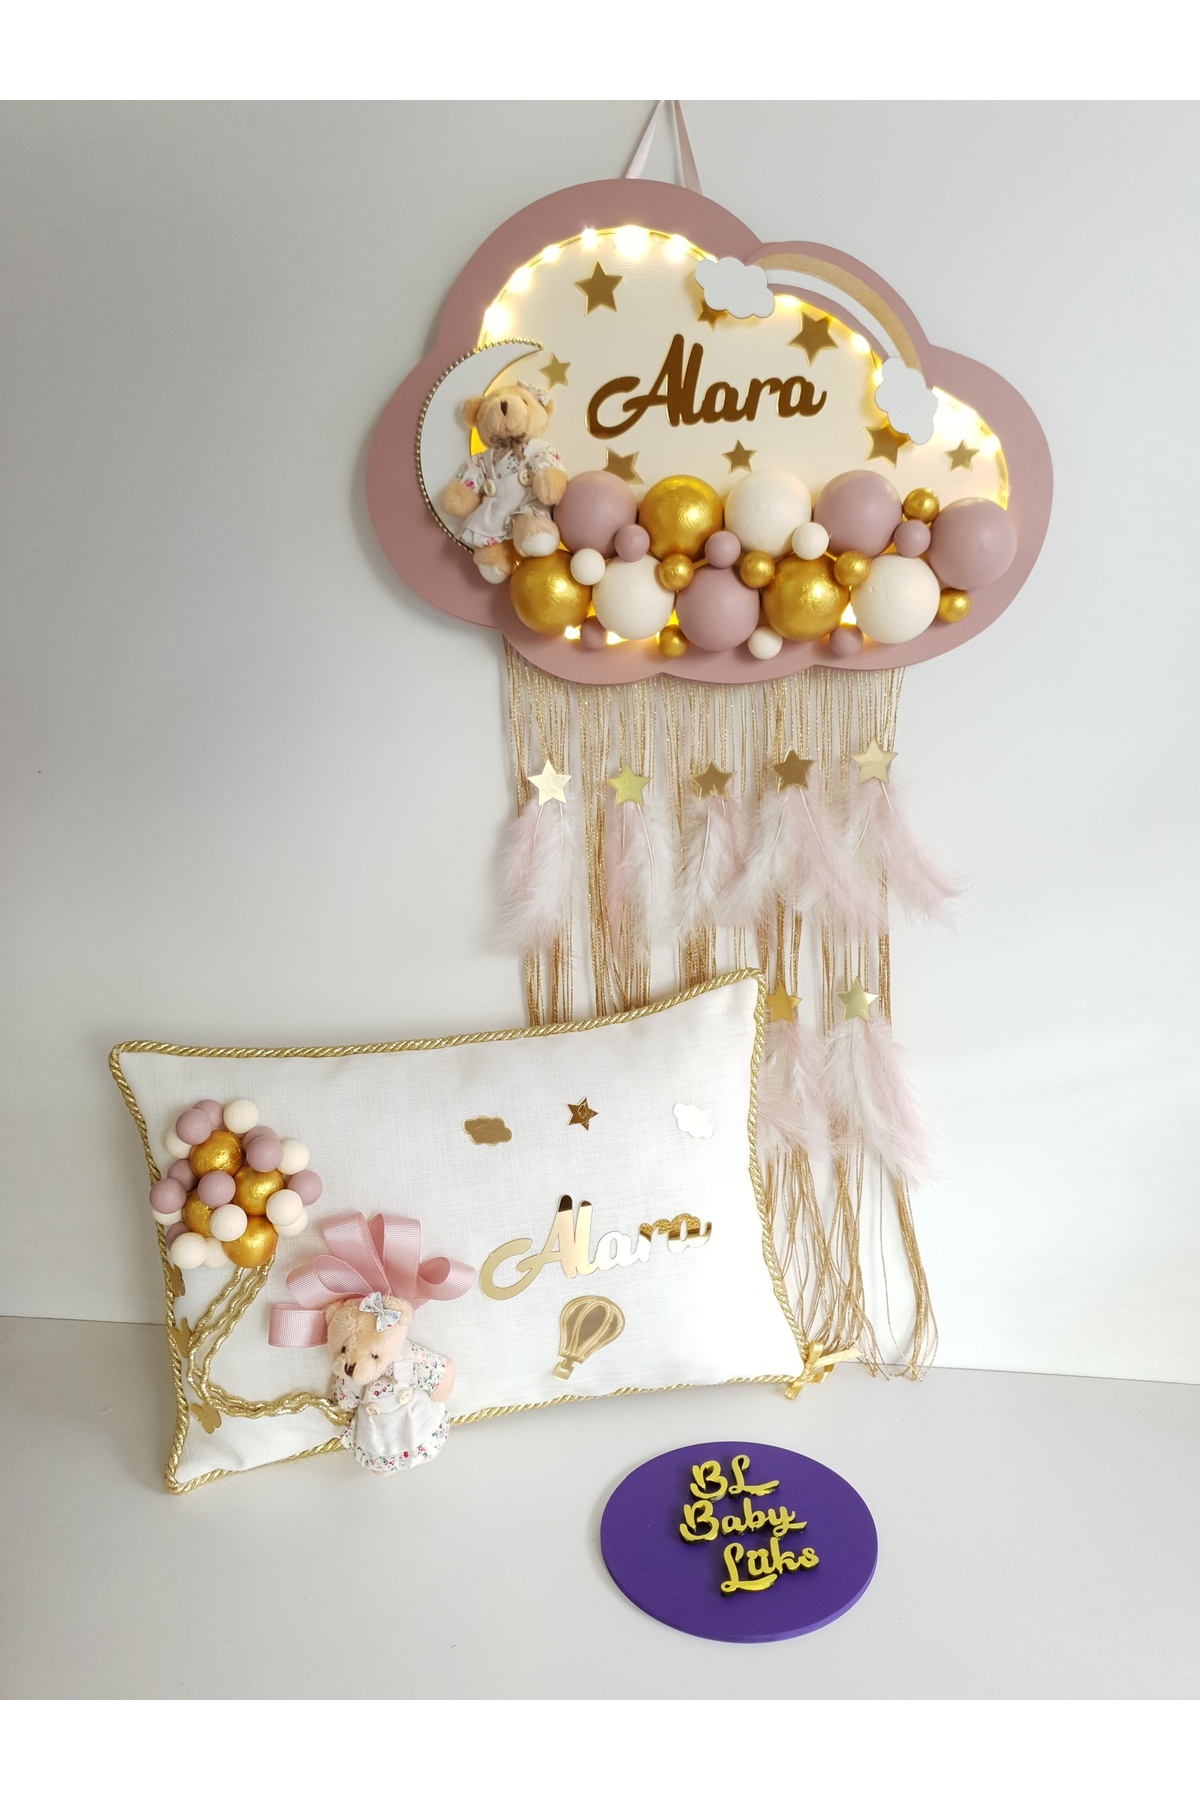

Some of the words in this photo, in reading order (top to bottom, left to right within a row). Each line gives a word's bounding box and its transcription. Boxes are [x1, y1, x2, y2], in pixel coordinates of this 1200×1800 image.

[585, 333, 827, 440] Alara
[479, 1194, 712, 1300] Alara
[690, 1455, 780, 1500] BL
[680, 1498, 807, 1543] Baby
[721, 1537, 819, 1595] Lüks
